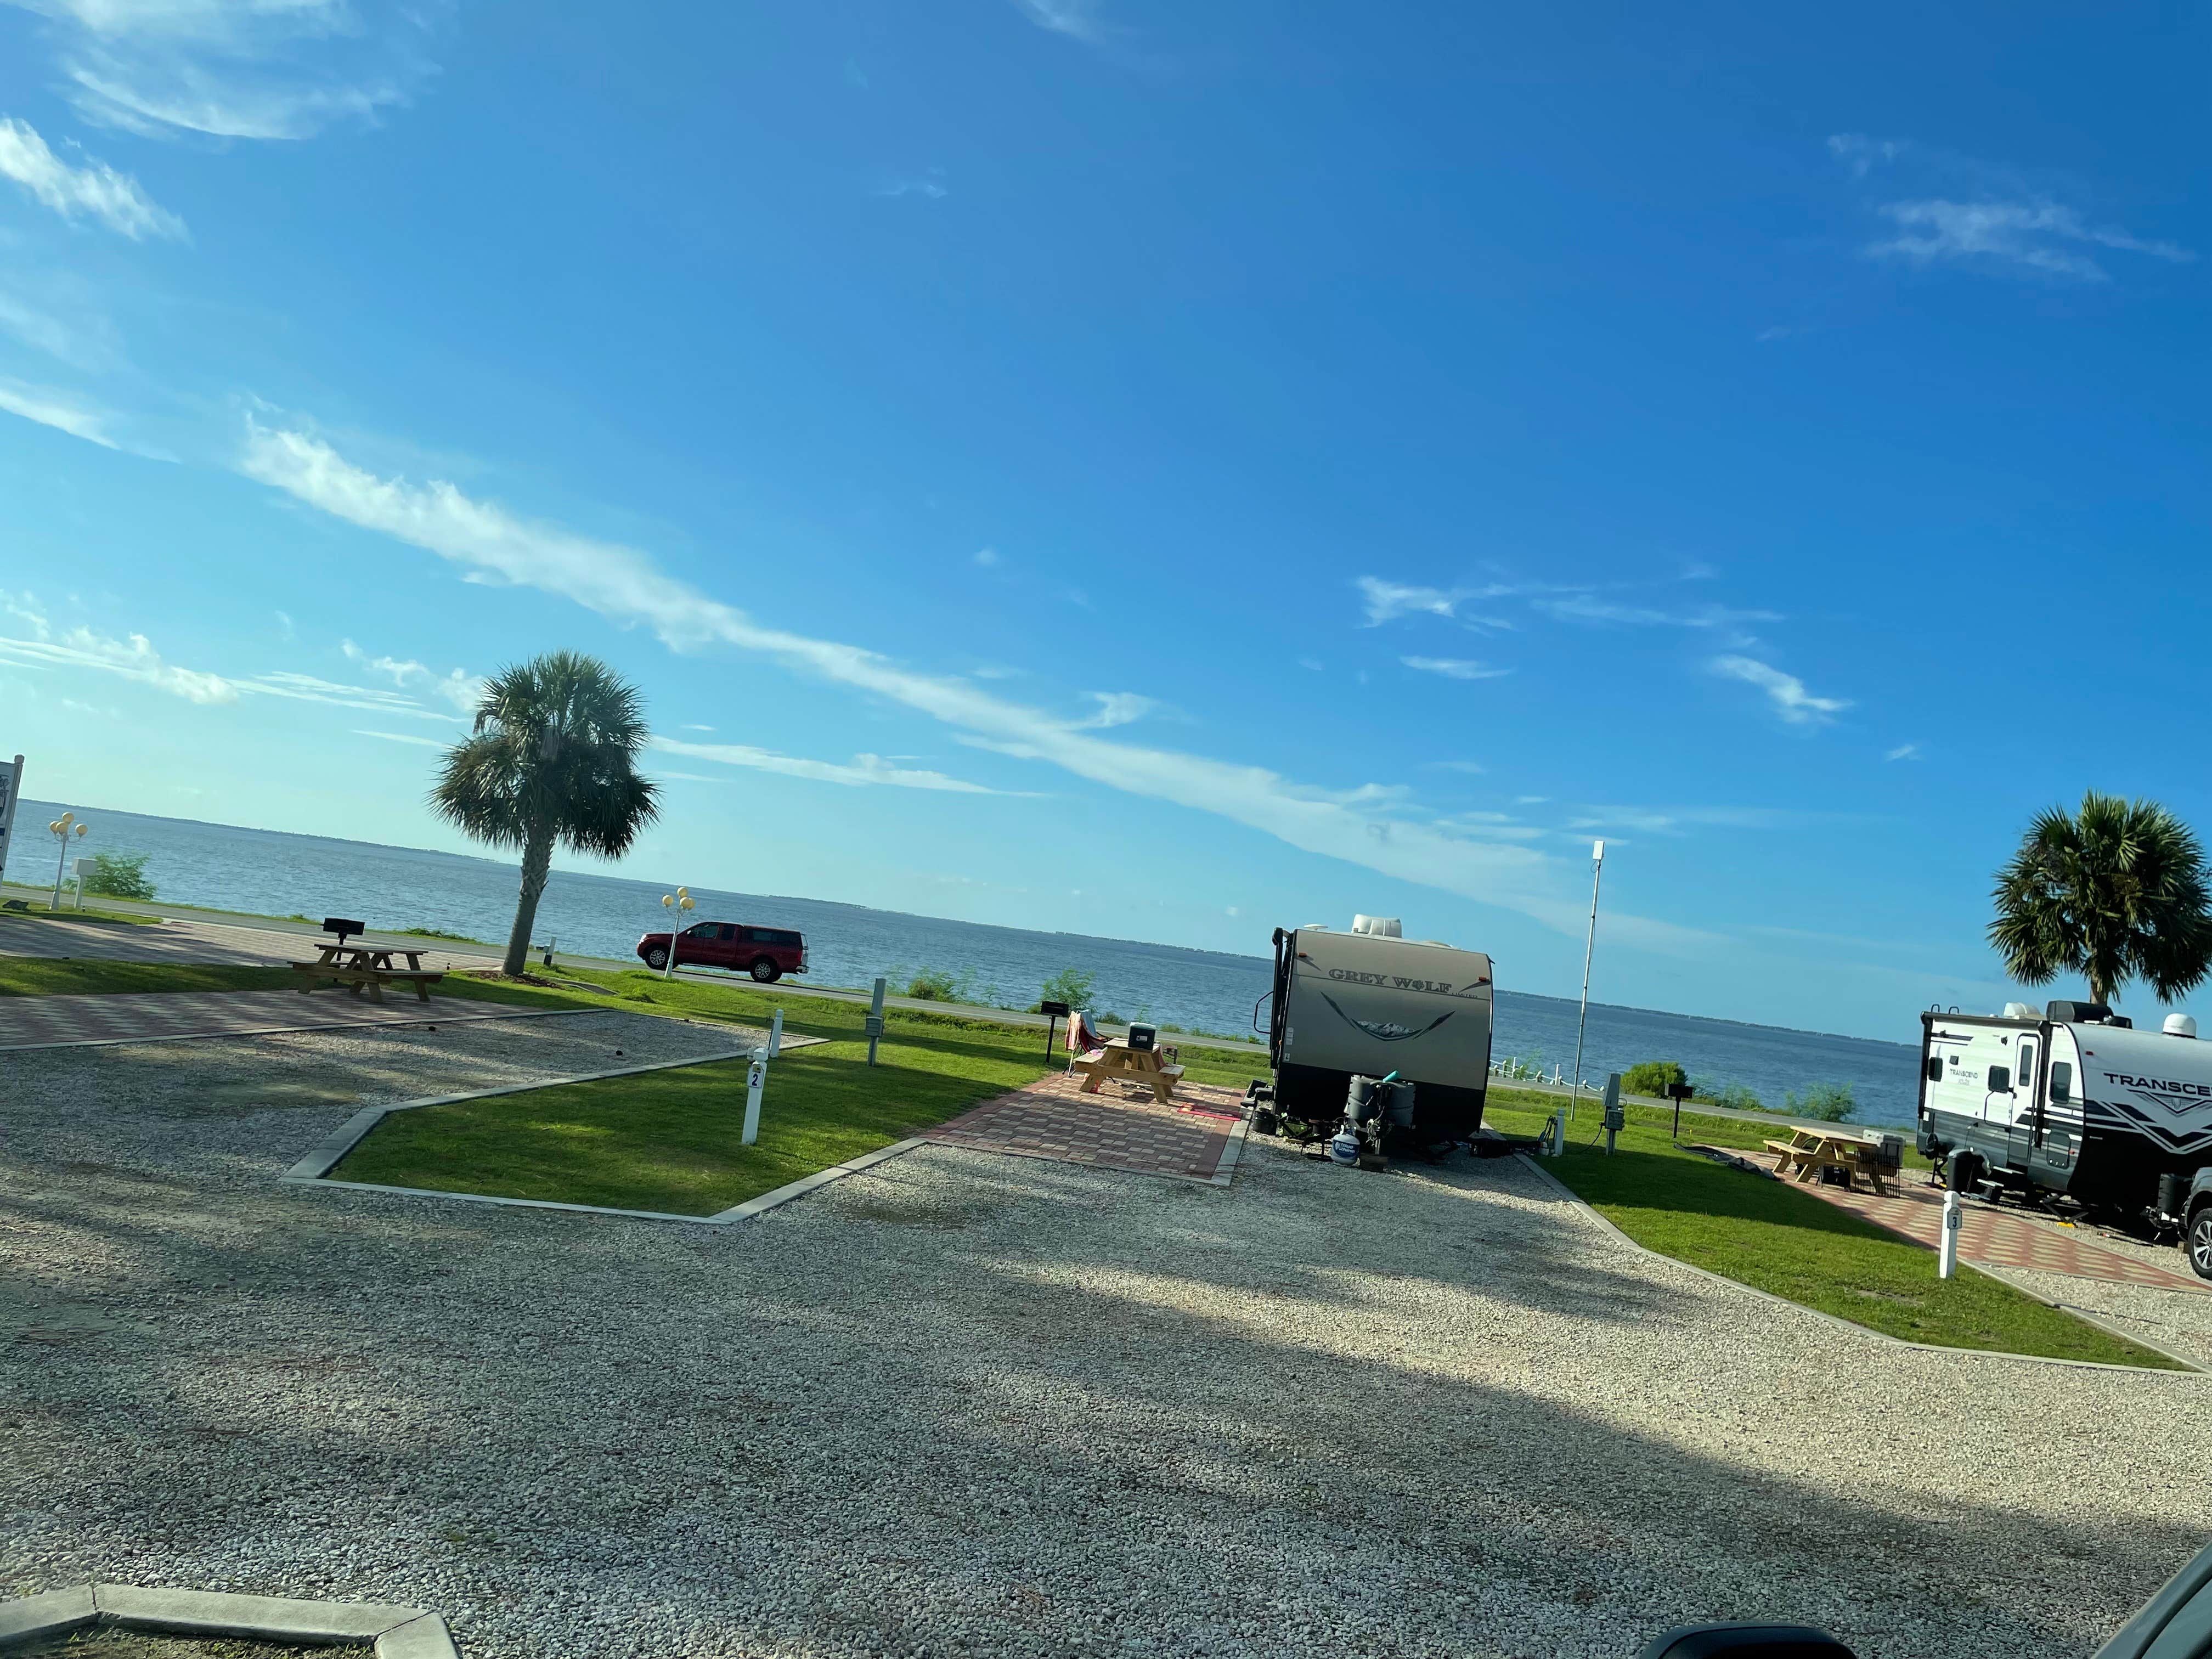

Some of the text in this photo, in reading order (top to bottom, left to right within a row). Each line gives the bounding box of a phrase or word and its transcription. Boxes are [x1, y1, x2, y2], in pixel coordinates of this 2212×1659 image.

[1329, 969, 1452, 993] GREY WOLF
[752, 1073, 758, 1086] 2
[1950, 1069, 1978, 1079] TRANSCEND
[2103, 1073, 2212, 1097] TRANSCE
[1953, 1216, 1957, 1228] 3
